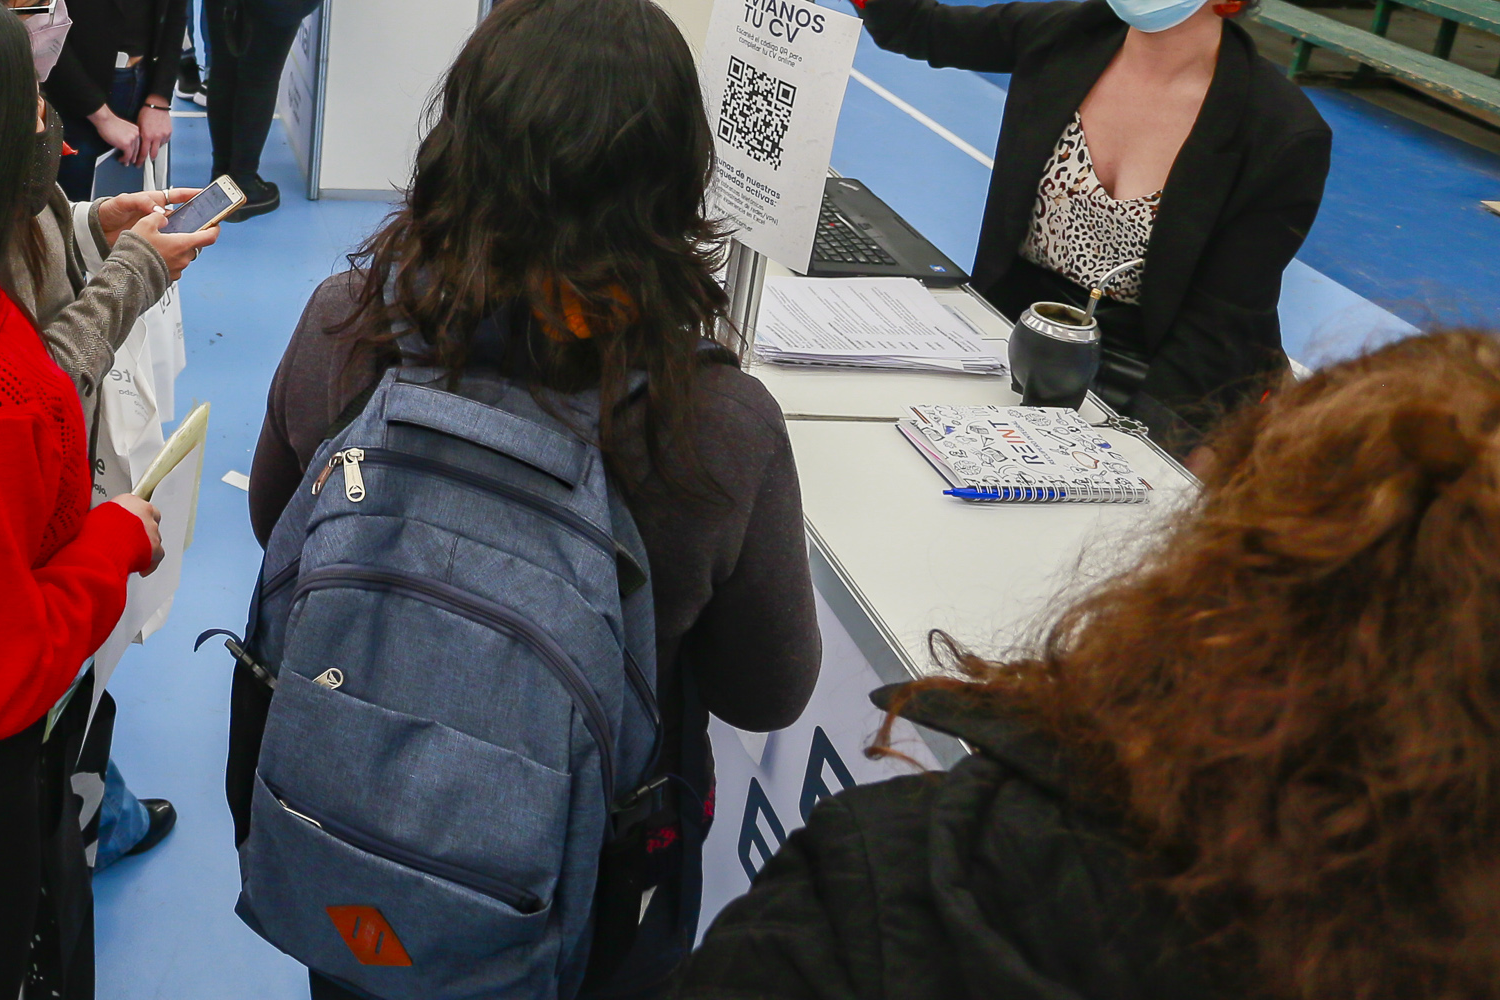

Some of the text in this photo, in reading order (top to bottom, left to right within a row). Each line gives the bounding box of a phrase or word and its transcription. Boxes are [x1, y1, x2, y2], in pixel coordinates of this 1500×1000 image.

[744, 3, 800, 43] TU CV
[738, 36, 761, 53] completar
[768, 50, 778, 61] CV
[777, 55, 796, 68] online
[760, 38, 778, 53] código
[779, 45, 789, 57] QR
[789, 51, 803, 63] para
[735, 168, 745, 180] de
[746, 175, 781, 200] nuestras
[745, 185, 777, 208] activas:
[987, 419, 1046, 465] REINT
